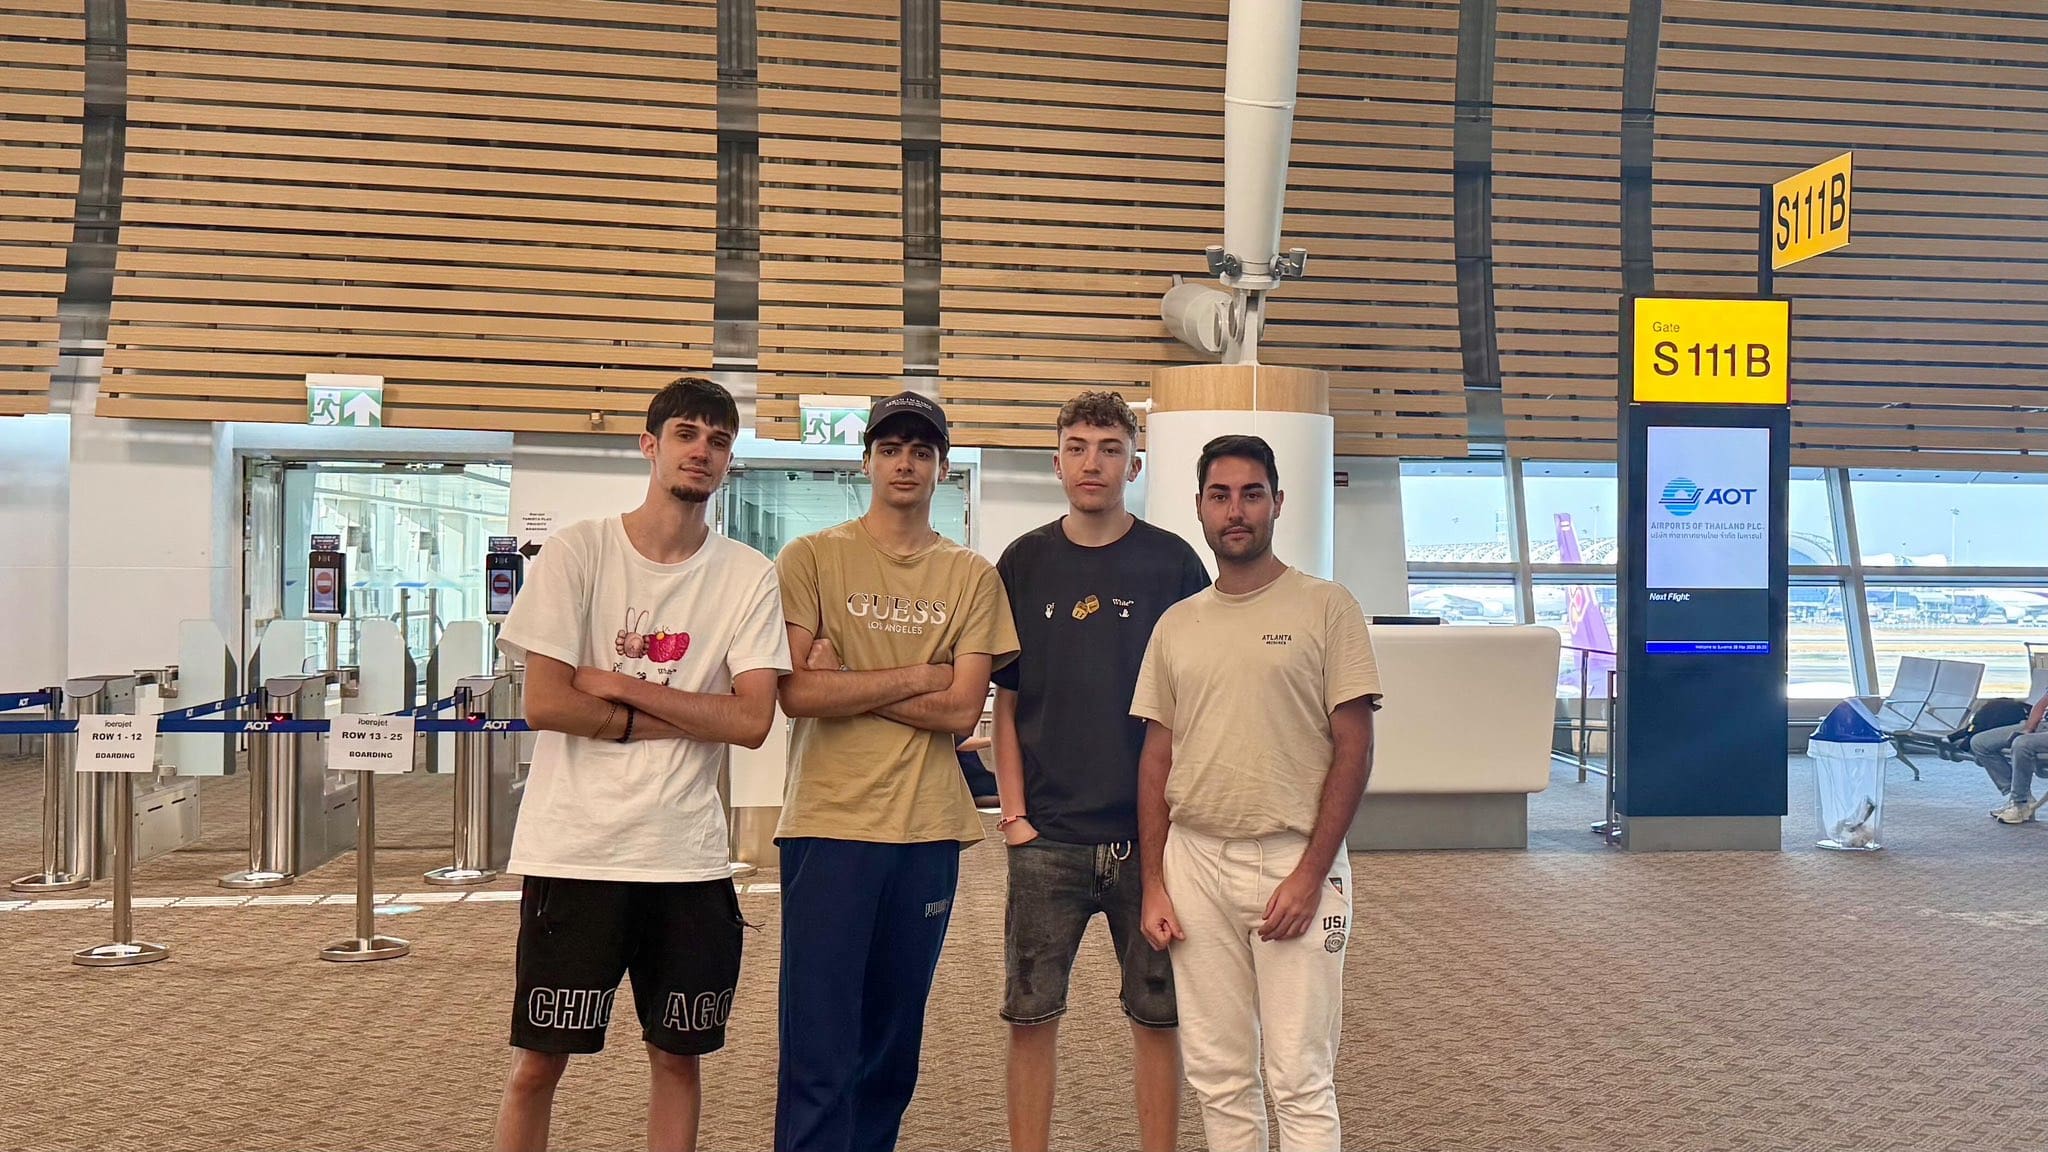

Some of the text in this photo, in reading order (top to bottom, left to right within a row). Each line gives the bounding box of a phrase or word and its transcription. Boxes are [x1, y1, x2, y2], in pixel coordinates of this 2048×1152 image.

[1777, 172, 1846, 251] S111B
[1653, 321, 1680, 333] Gate
[1705, 488, 1757, 505] AOT
[1651, 522, 1690, 530] AIRPORTS
[1692, 522, 1702, 530] OF
[1705, 522, 1745, 530] THAILAND
[1649, 592, 1690, 602] Next Flight
[847, 592, 946, 625] GUESS
[868, 621, 922, 635] LOS ANGELES
[244, 721, 272, 731] AOT
[482, 720, 511, 730] AOT
[92, 733, 114, 741] ROW
[117, 733, 122, 741] 1
[131, 733, 142, 741] 12
[342, 731, 366, 740] ROW
[369, 732, 381, 740] 13
[390, 733, 403, 741] 25
[349, 751, 393, 759] BOARDING
